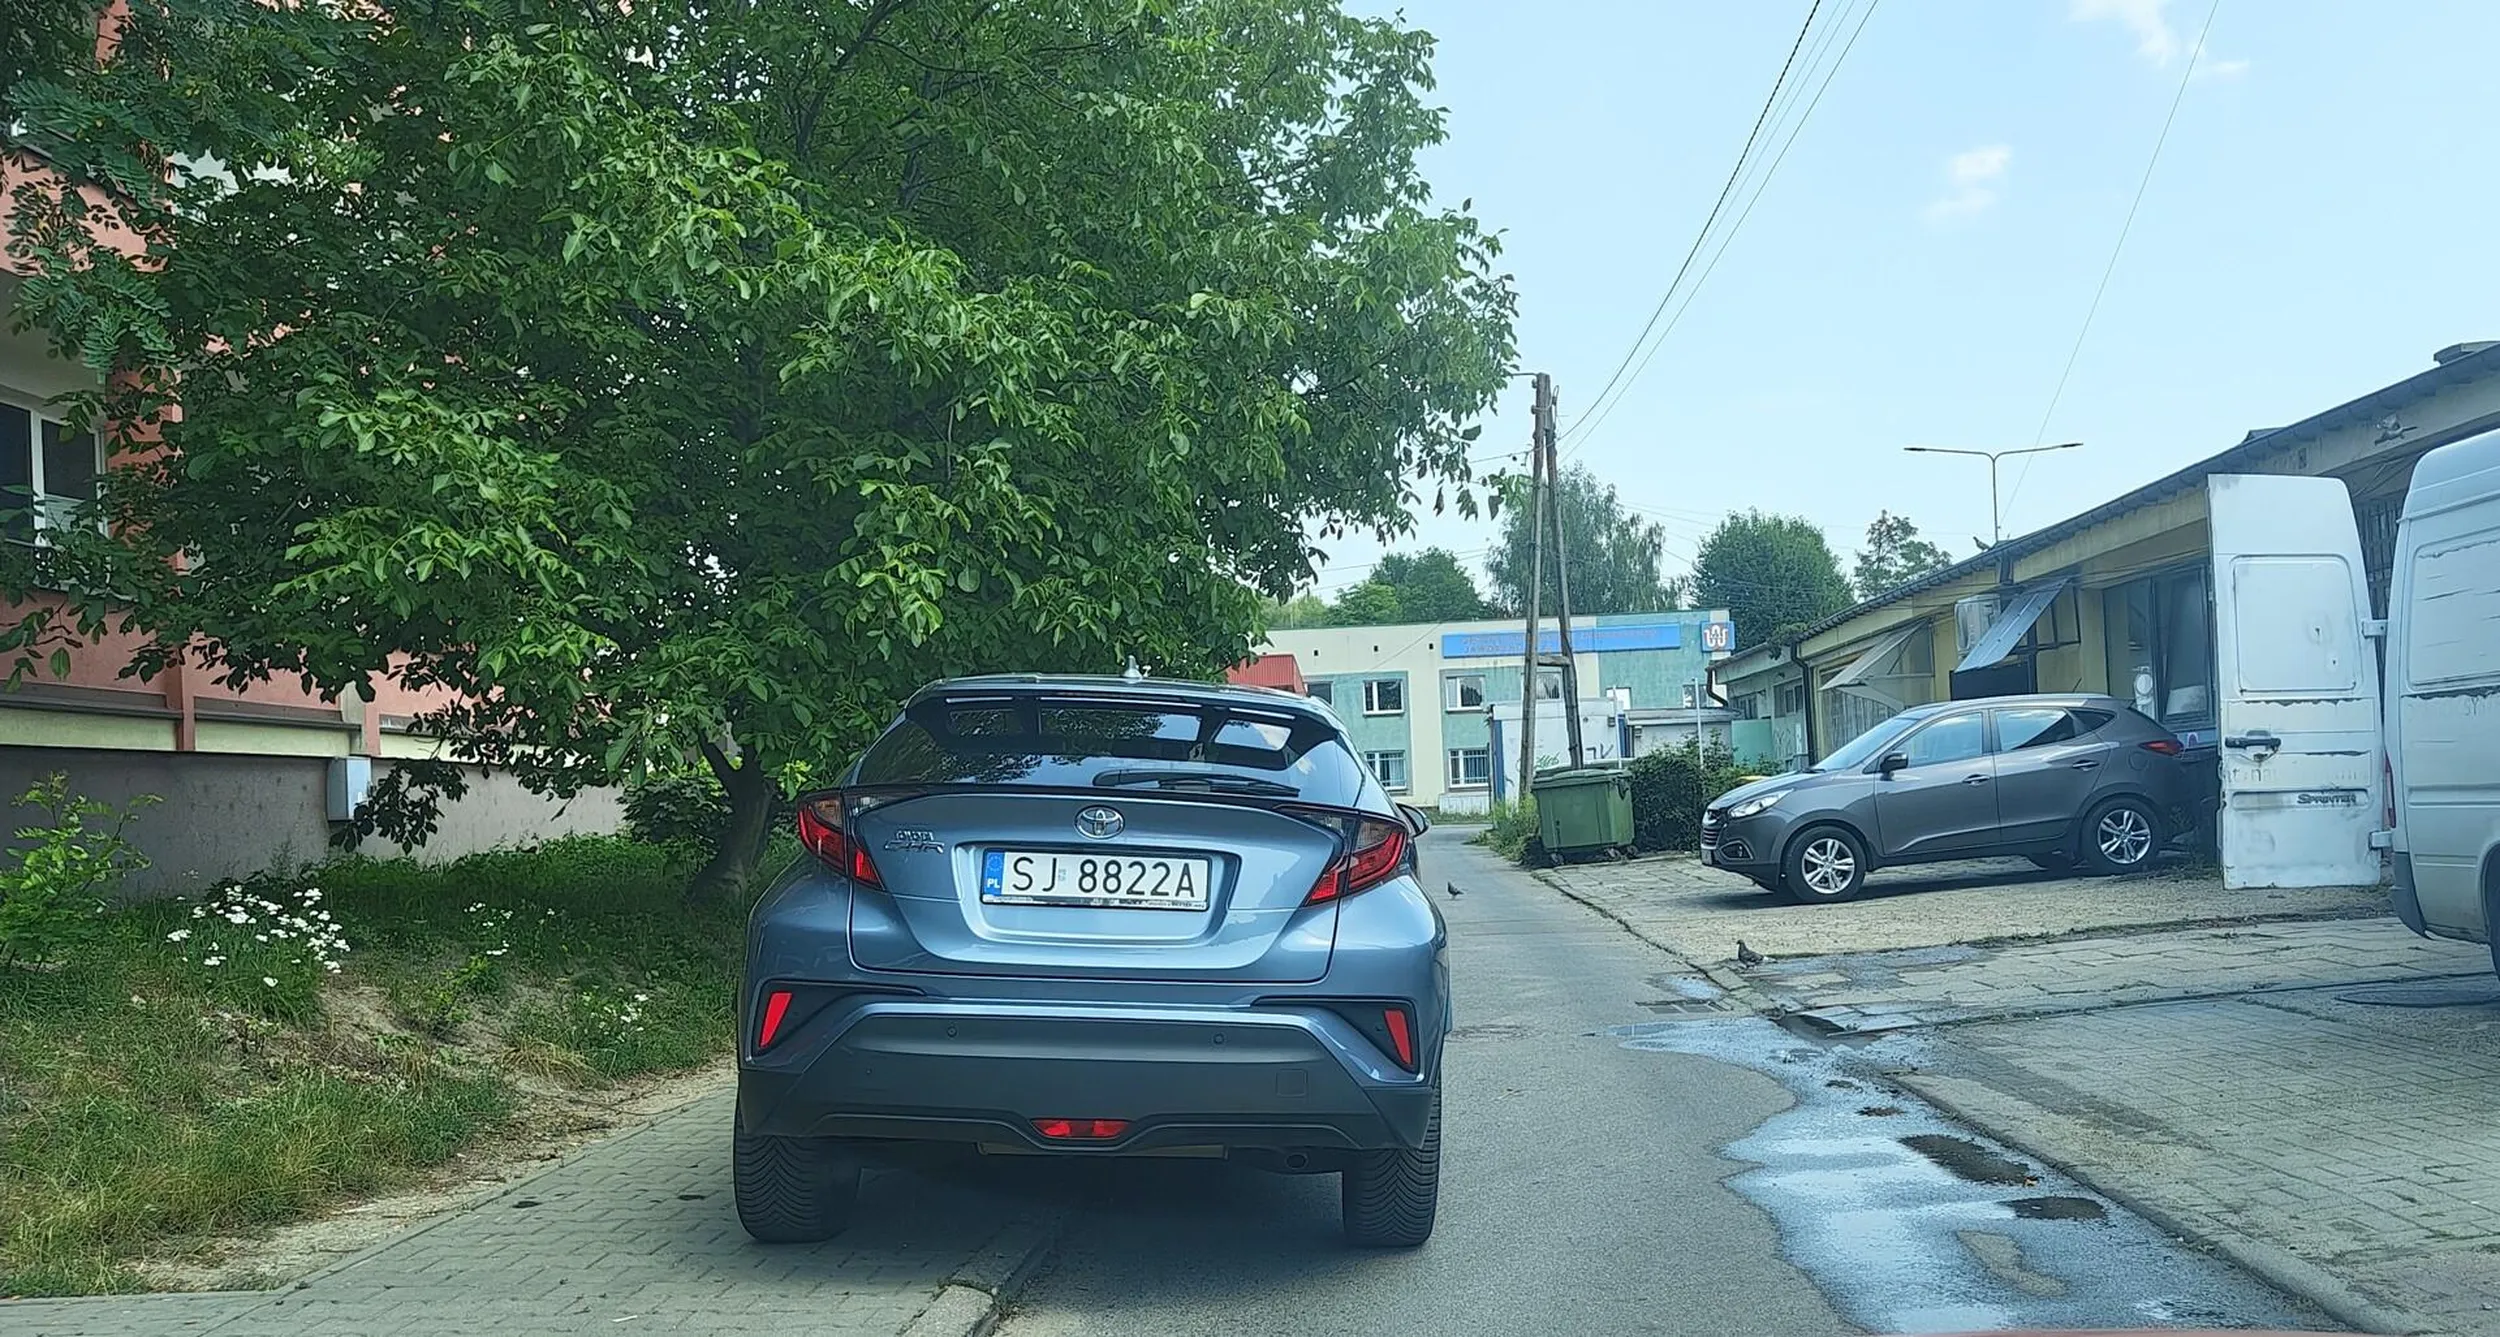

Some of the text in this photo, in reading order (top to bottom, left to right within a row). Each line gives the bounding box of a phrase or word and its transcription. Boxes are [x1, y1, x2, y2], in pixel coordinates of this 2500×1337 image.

[986, 876, 1000, 887] PL
[1012, 855, 1196, 896] SJ 8822A
